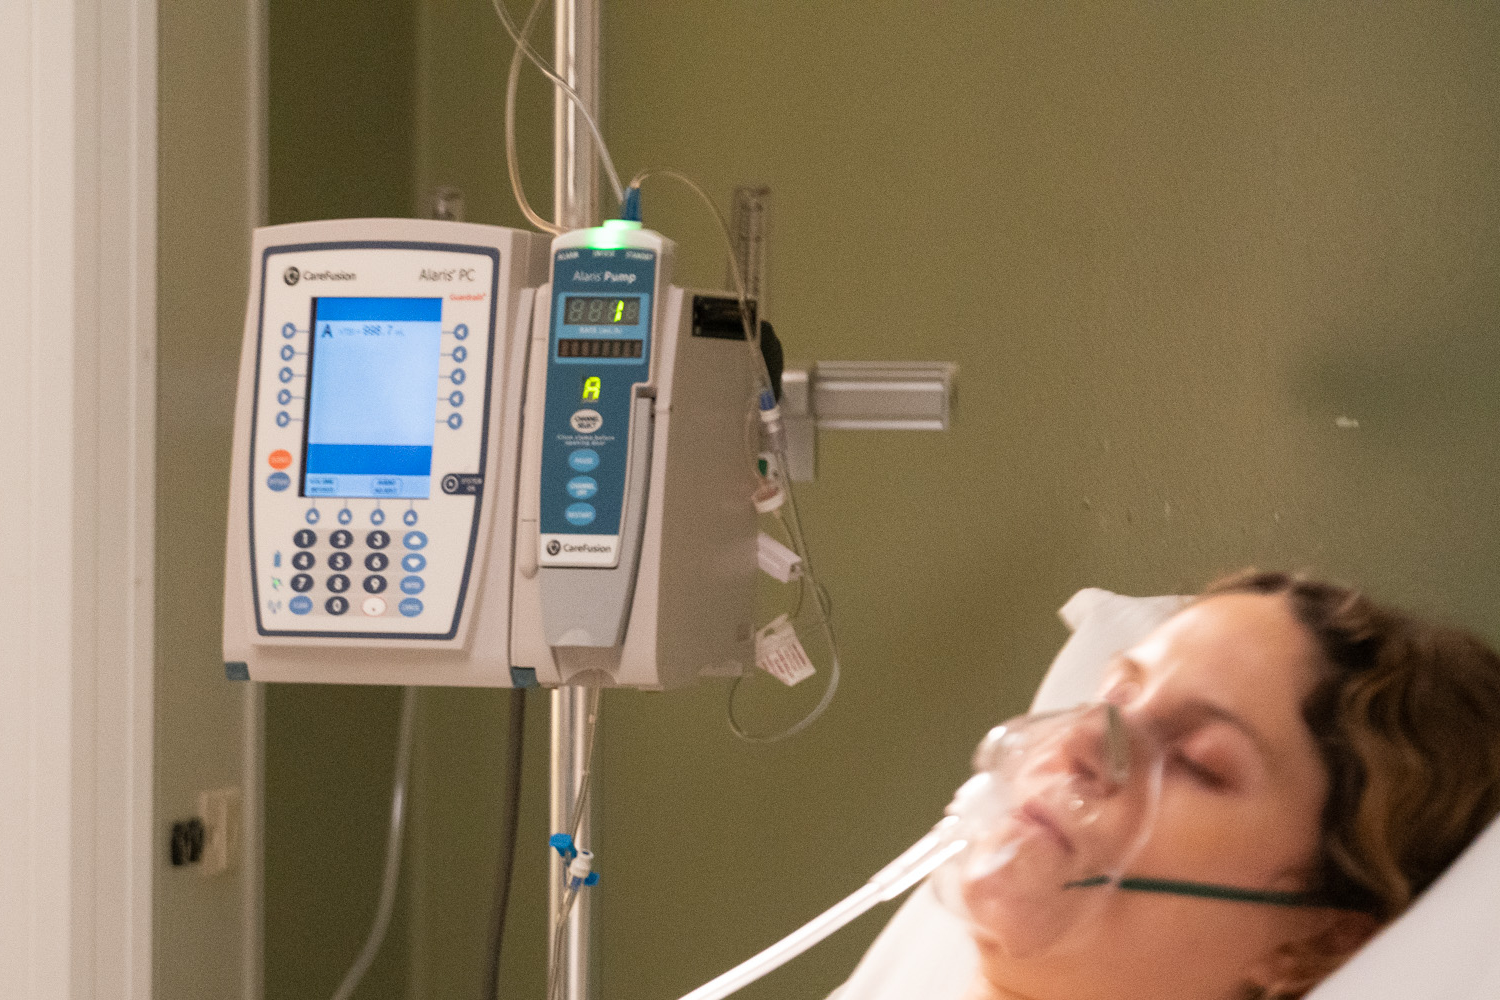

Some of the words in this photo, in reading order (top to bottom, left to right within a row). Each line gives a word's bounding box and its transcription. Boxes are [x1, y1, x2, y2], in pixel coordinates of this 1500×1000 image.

[303, 269, 357, 282] CareFusion
[458, 268, 476, 282] PC
[603, 270, 637, 284] Pump
[321, 324, 333, 338] A
[582, 376, 601, 400] A
[302, 533, 309, 545] 1
[338, 534, 347, 546] 2
[374, 534, 383, 546] 3
[563, 543, 612, 553] CareFusion
[299, 555, 308, 568] 4
[336, 555, 344, 568] 5
[372, 555, 381, 568] 6
[298, 576, 307, 590] 7
[334, 577, 343, 591] 8
[370, 577, 380, 591] 9
